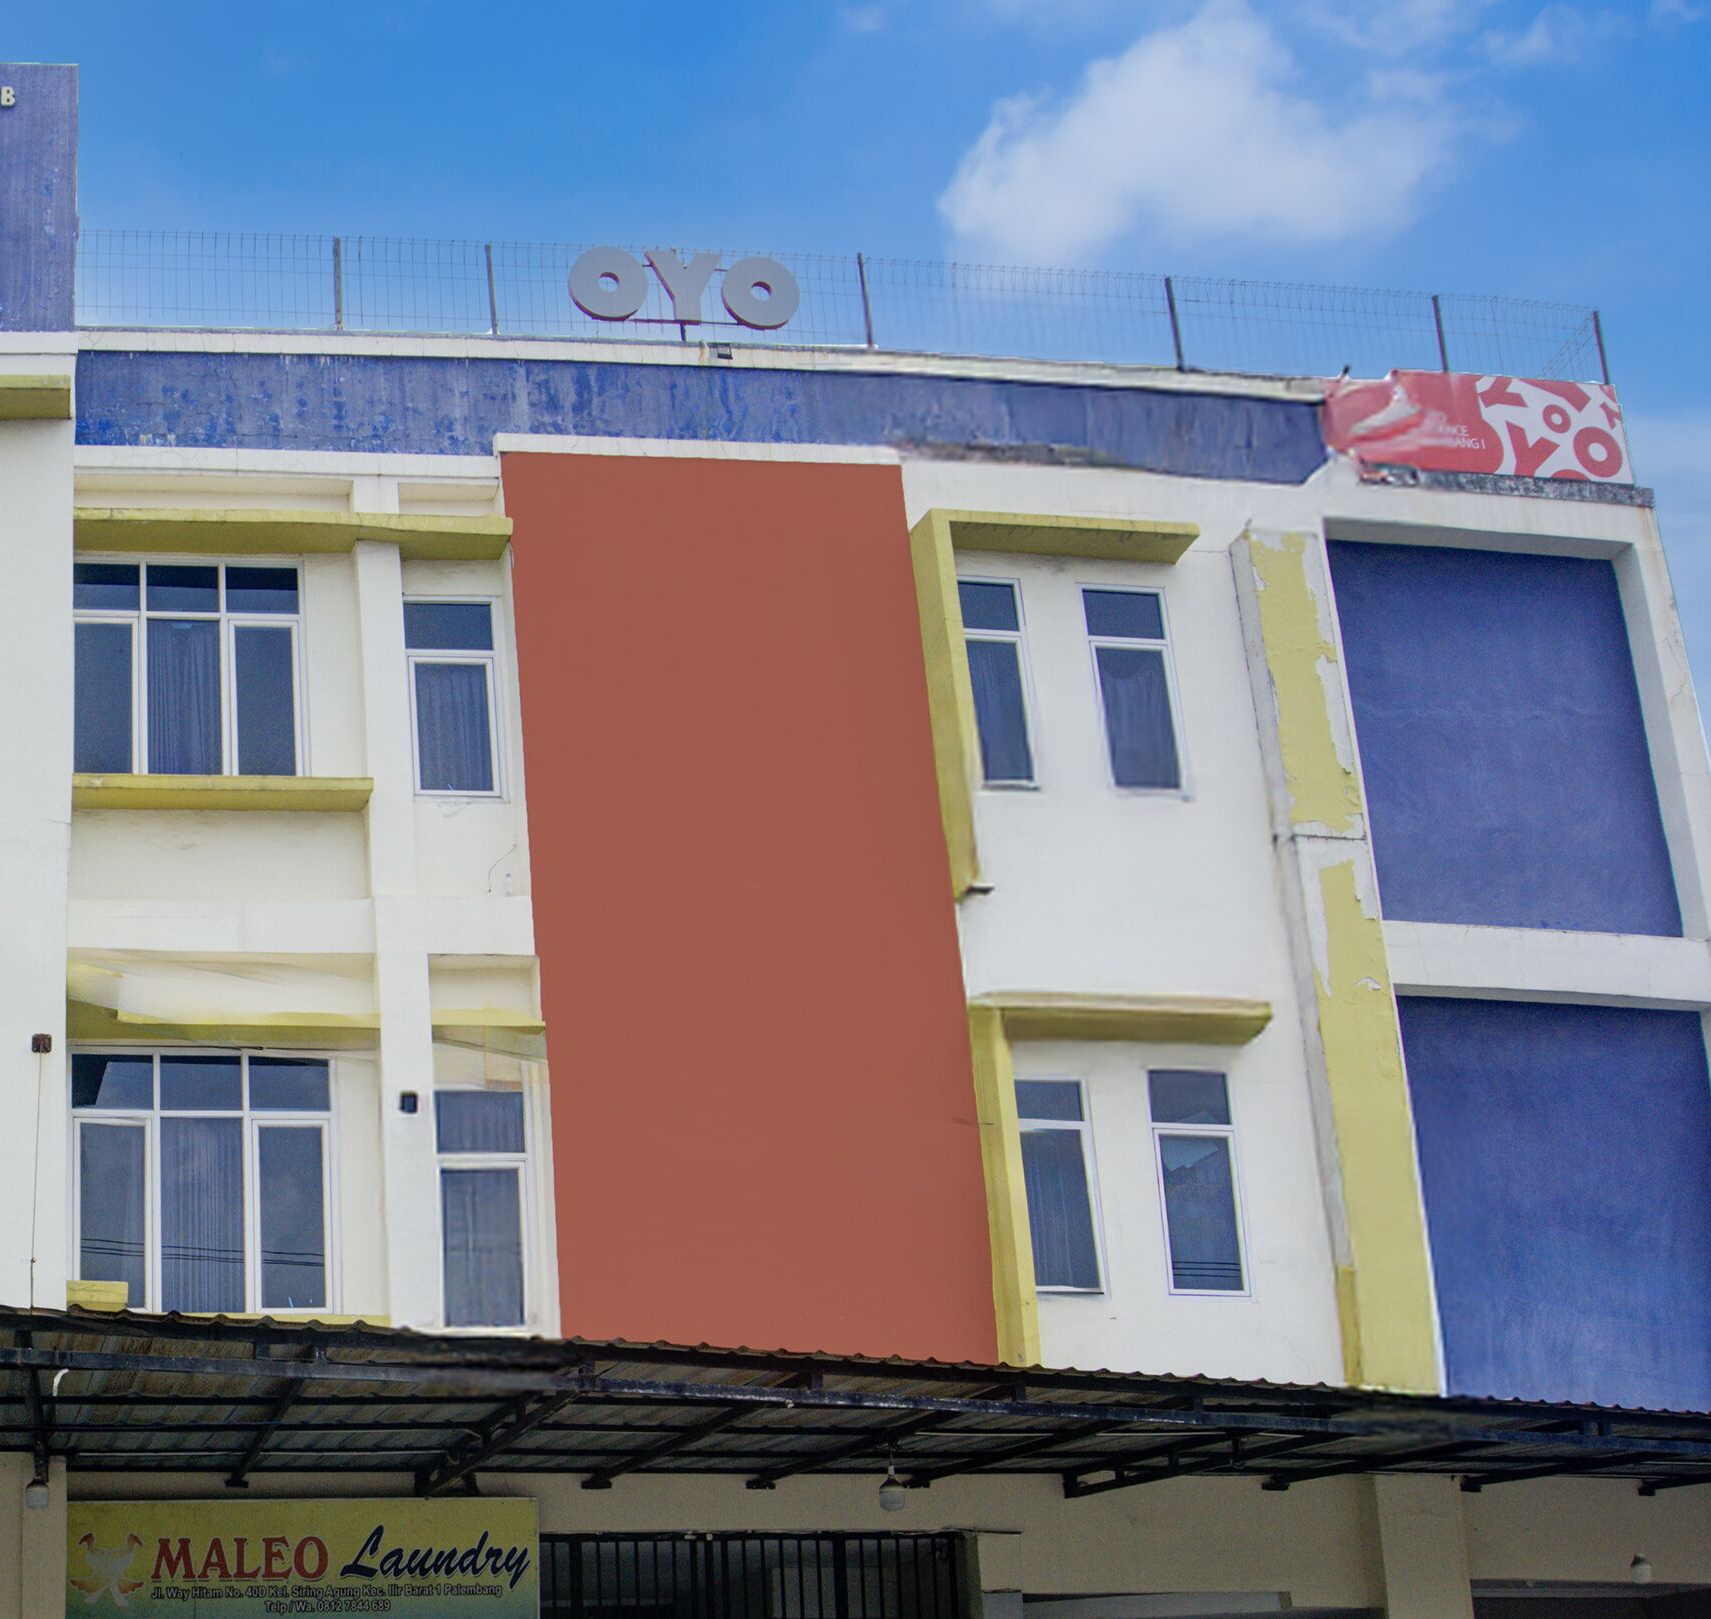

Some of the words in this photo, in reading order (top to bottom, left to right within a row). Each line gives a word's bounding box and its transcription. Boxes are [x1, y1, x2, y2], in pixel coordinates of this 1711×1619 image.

[568, 246, 800, 330] OYO
[151, 1536, 329, 1580] MALEO
[340, 1525, 530, 1589] Laundry
[166, 1588, 189, 1600] Way
[192, 1587, 222, 1599] Hitam
[225, 1587, 243, 1599] No.
[269, 1586, 289, 1598] Kel.
[292, 1586, 324, 1599] Siring
[325, 1586, 361, 1600] Agung
[362, 1586, 386, 1597] Kec.
[405, 1585, 434, 1597] Barat
[444, 1585, 502, 1598] Palembang
[317, 1600, 342, 1612] 0812
[344, 1599, 369, 1612] 7844
[371, 1599, 391, 1611] 689
